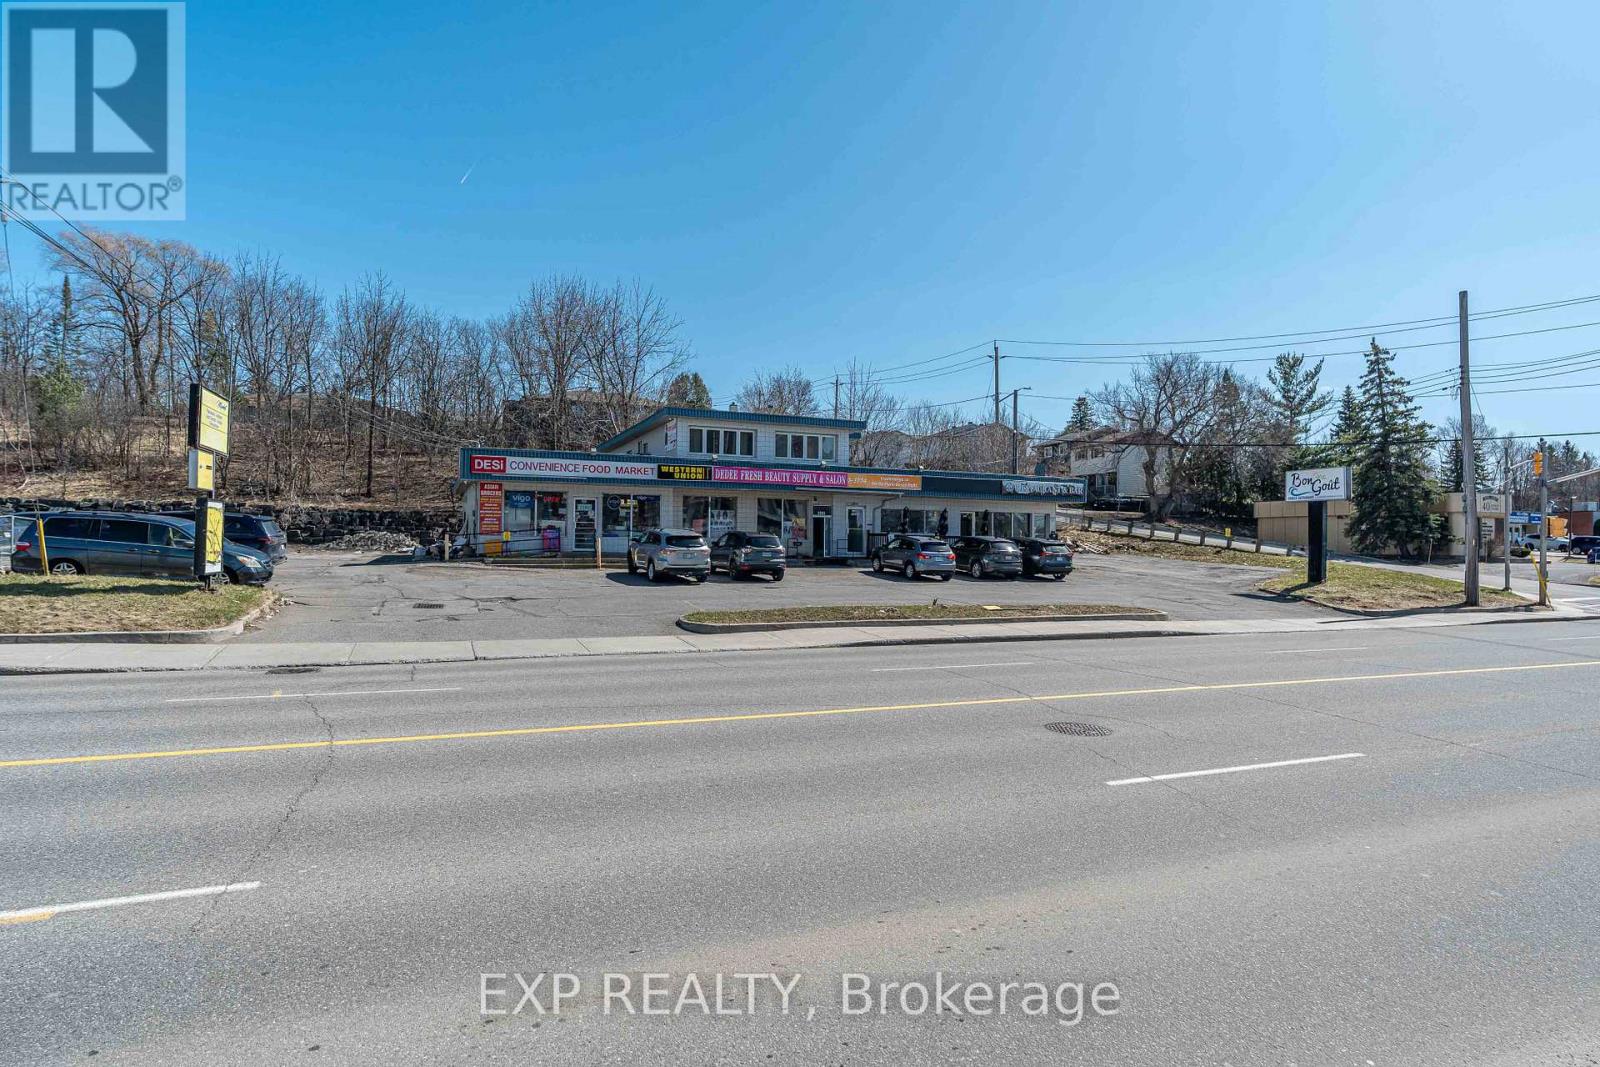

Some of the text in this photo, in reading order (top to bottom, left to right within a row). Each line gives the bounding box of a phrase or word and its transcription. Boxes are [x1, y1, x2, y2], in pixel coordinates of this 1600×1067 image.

[509, 460, 580, 473] CONVENIENCE
[582, 464, 611, 474] FOOD
[615, 466, 656, 476] MARKET
[661, 466, 703, 474] WESTERN
[740, 470, 762, 481] FRESH
[764, 471, 790, 482] BEAUTY
[792, 472, 817, 484] SUPPLY
[819, 474, 824, 484] &
[825, 474, 847, 485] SALON
[1291, 472, 1313, 488] Bon
